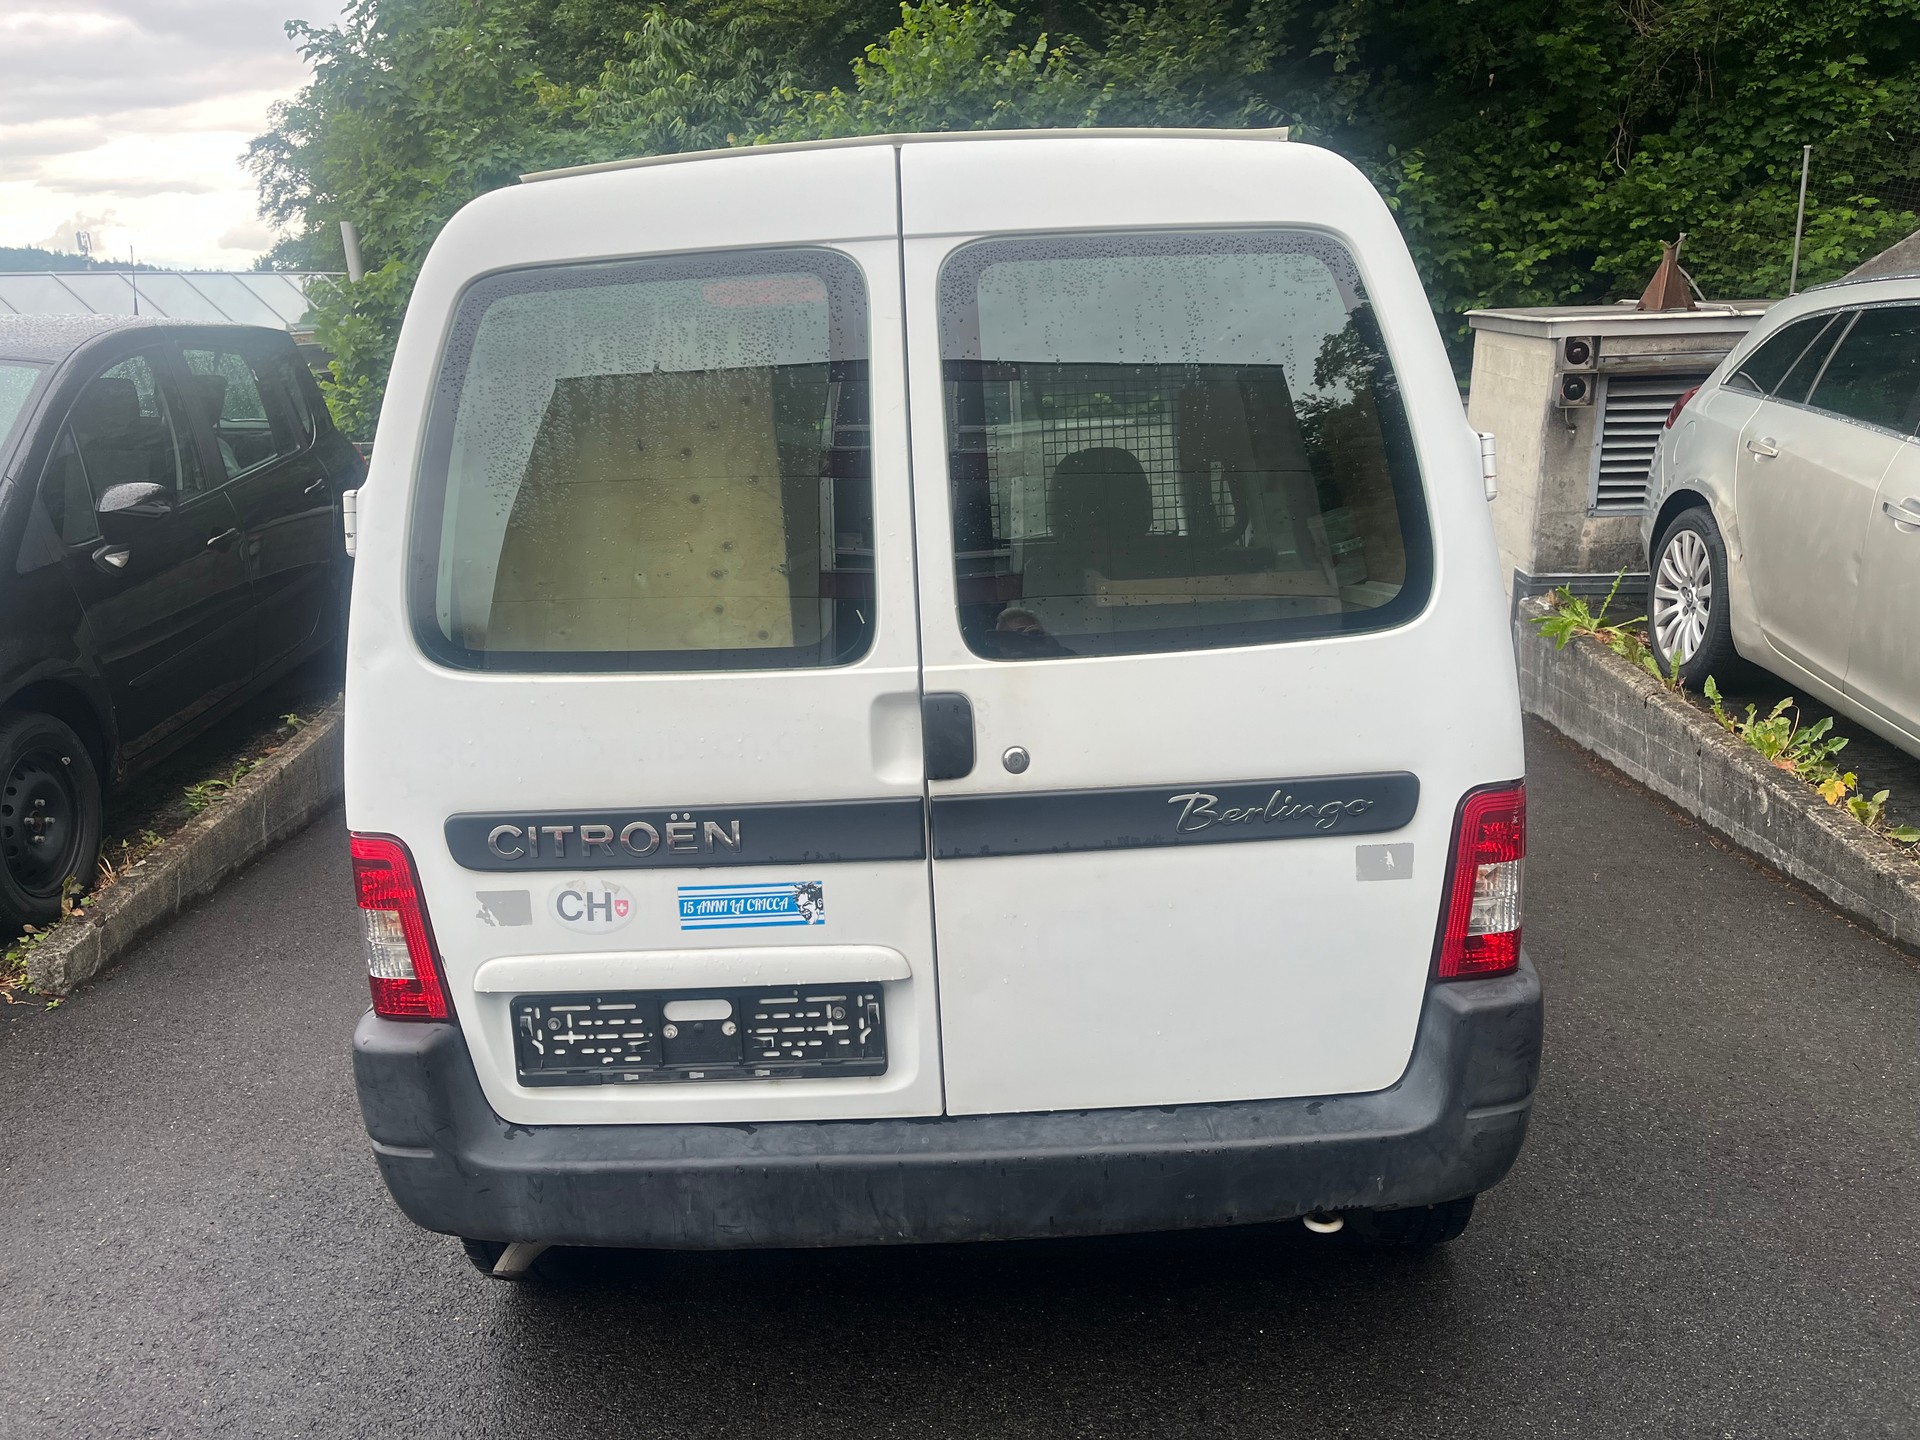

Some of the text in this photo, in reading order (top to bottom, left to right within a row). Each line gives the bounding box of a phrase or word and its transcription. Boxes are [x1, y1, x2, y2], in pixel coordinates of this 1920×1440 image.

[1168, 790, 1374, 834] Berlingo
[488, 813, 742, 861] CITROËN
[556, 890, 613, 922] CH
[683, 897, 788, 915] 15 ANNI LA CRICCA
